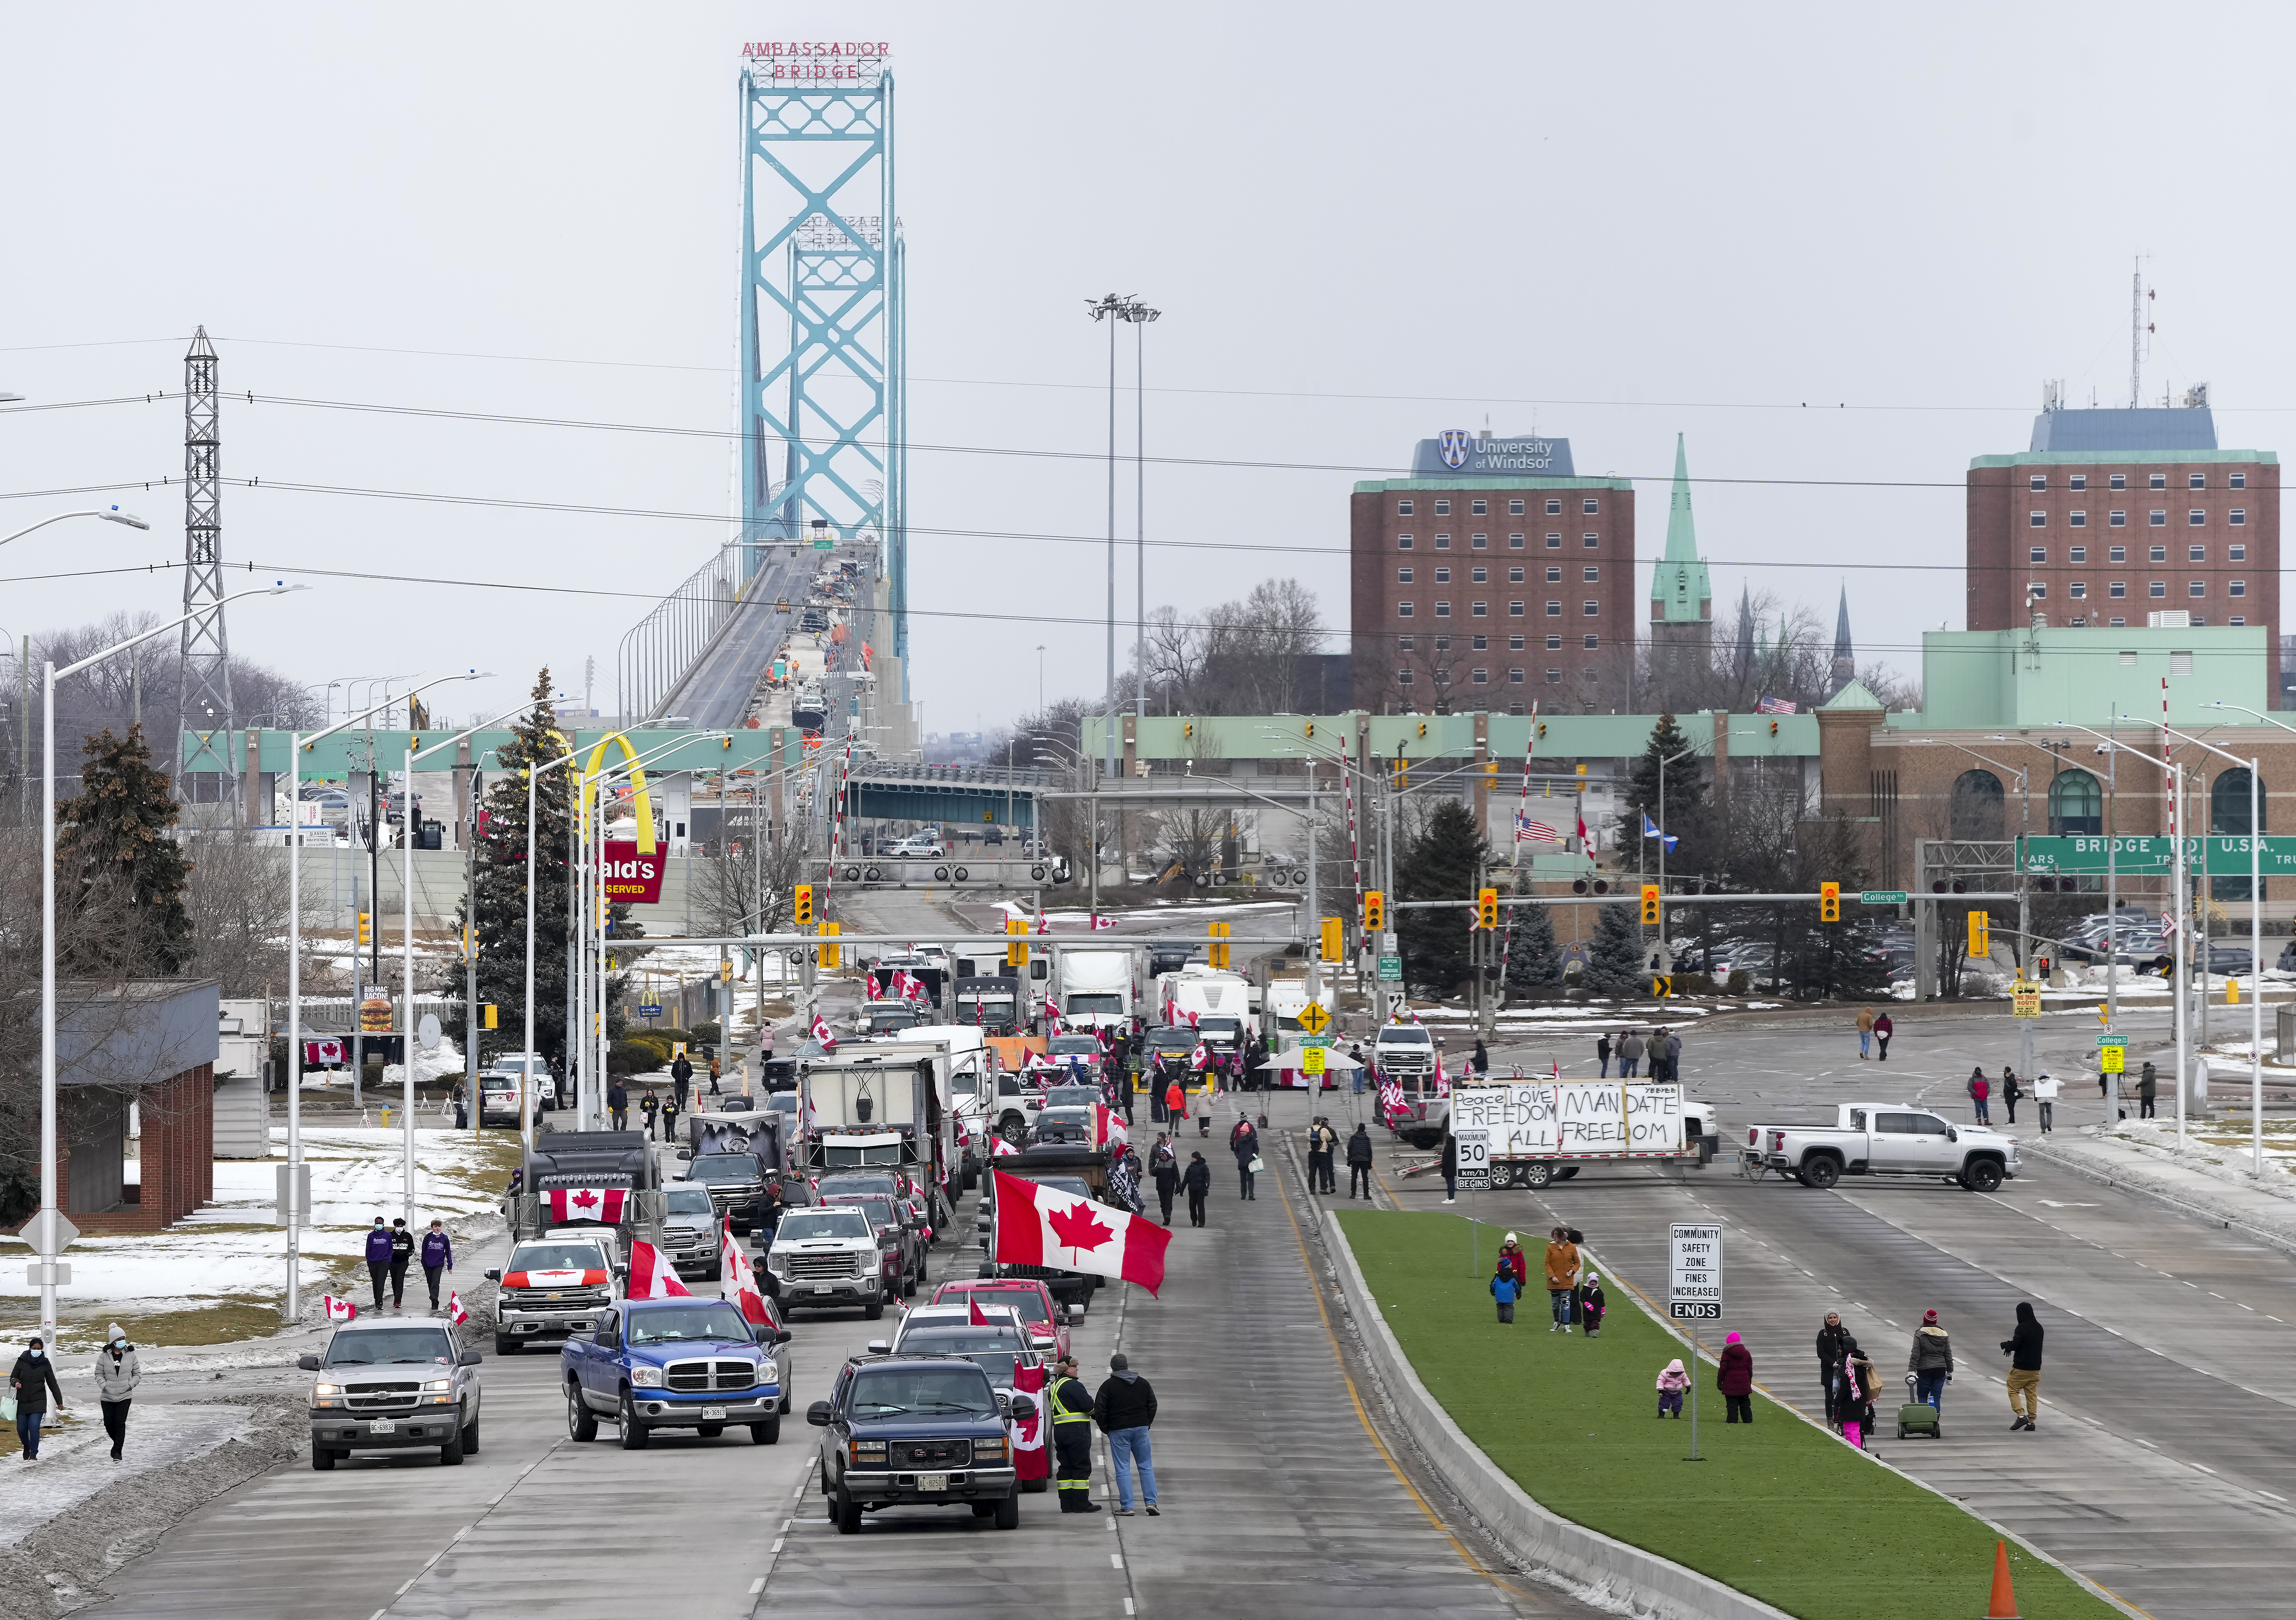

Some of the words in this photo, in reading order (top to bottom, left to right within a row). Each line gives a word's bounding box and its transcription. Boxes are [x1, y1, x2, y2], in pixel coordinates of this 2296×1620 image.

[742, 42, 889, 55] AMBASSADOR
[775, 66, 858, 78] BRIDGE
[1475, 439, 1553, 457] University
[1475, 459, 1486, 469] of
[1488, 455, 1553, 469] Windsor
[2075, 839, 2150, 852] BRIDGE
[606, 885, 645, 893] SERVED
[1864, 893, 1896, 903] College
[1299, 1038, 1323, 1046] College
[2097, 1037, 2121, 1045] College
[1455, 1093, 1504, 1106] Peace
[1510, 1091, 1553, 1105] LOVE
[1457, 1103, 1556, 1125] FREEDOM
[1510, 1130, 1555, 1146] ALL
[1561, 1121, 1667, 1143] FREEDOM
[1460, 1144, 1485, 1162] 50
[1674, 1229, 1719, 1239] COMMUNITY
[1682, 1244, 1711, 1253] SAFETY
[1686, 1257, 1706, 1267] ZONE
[1685, 1274, 1707, 1283] FINES
[1673, 1287, 1719, 1296] INCREASED
[1675, 1304, 1716, 1317] ENDS
